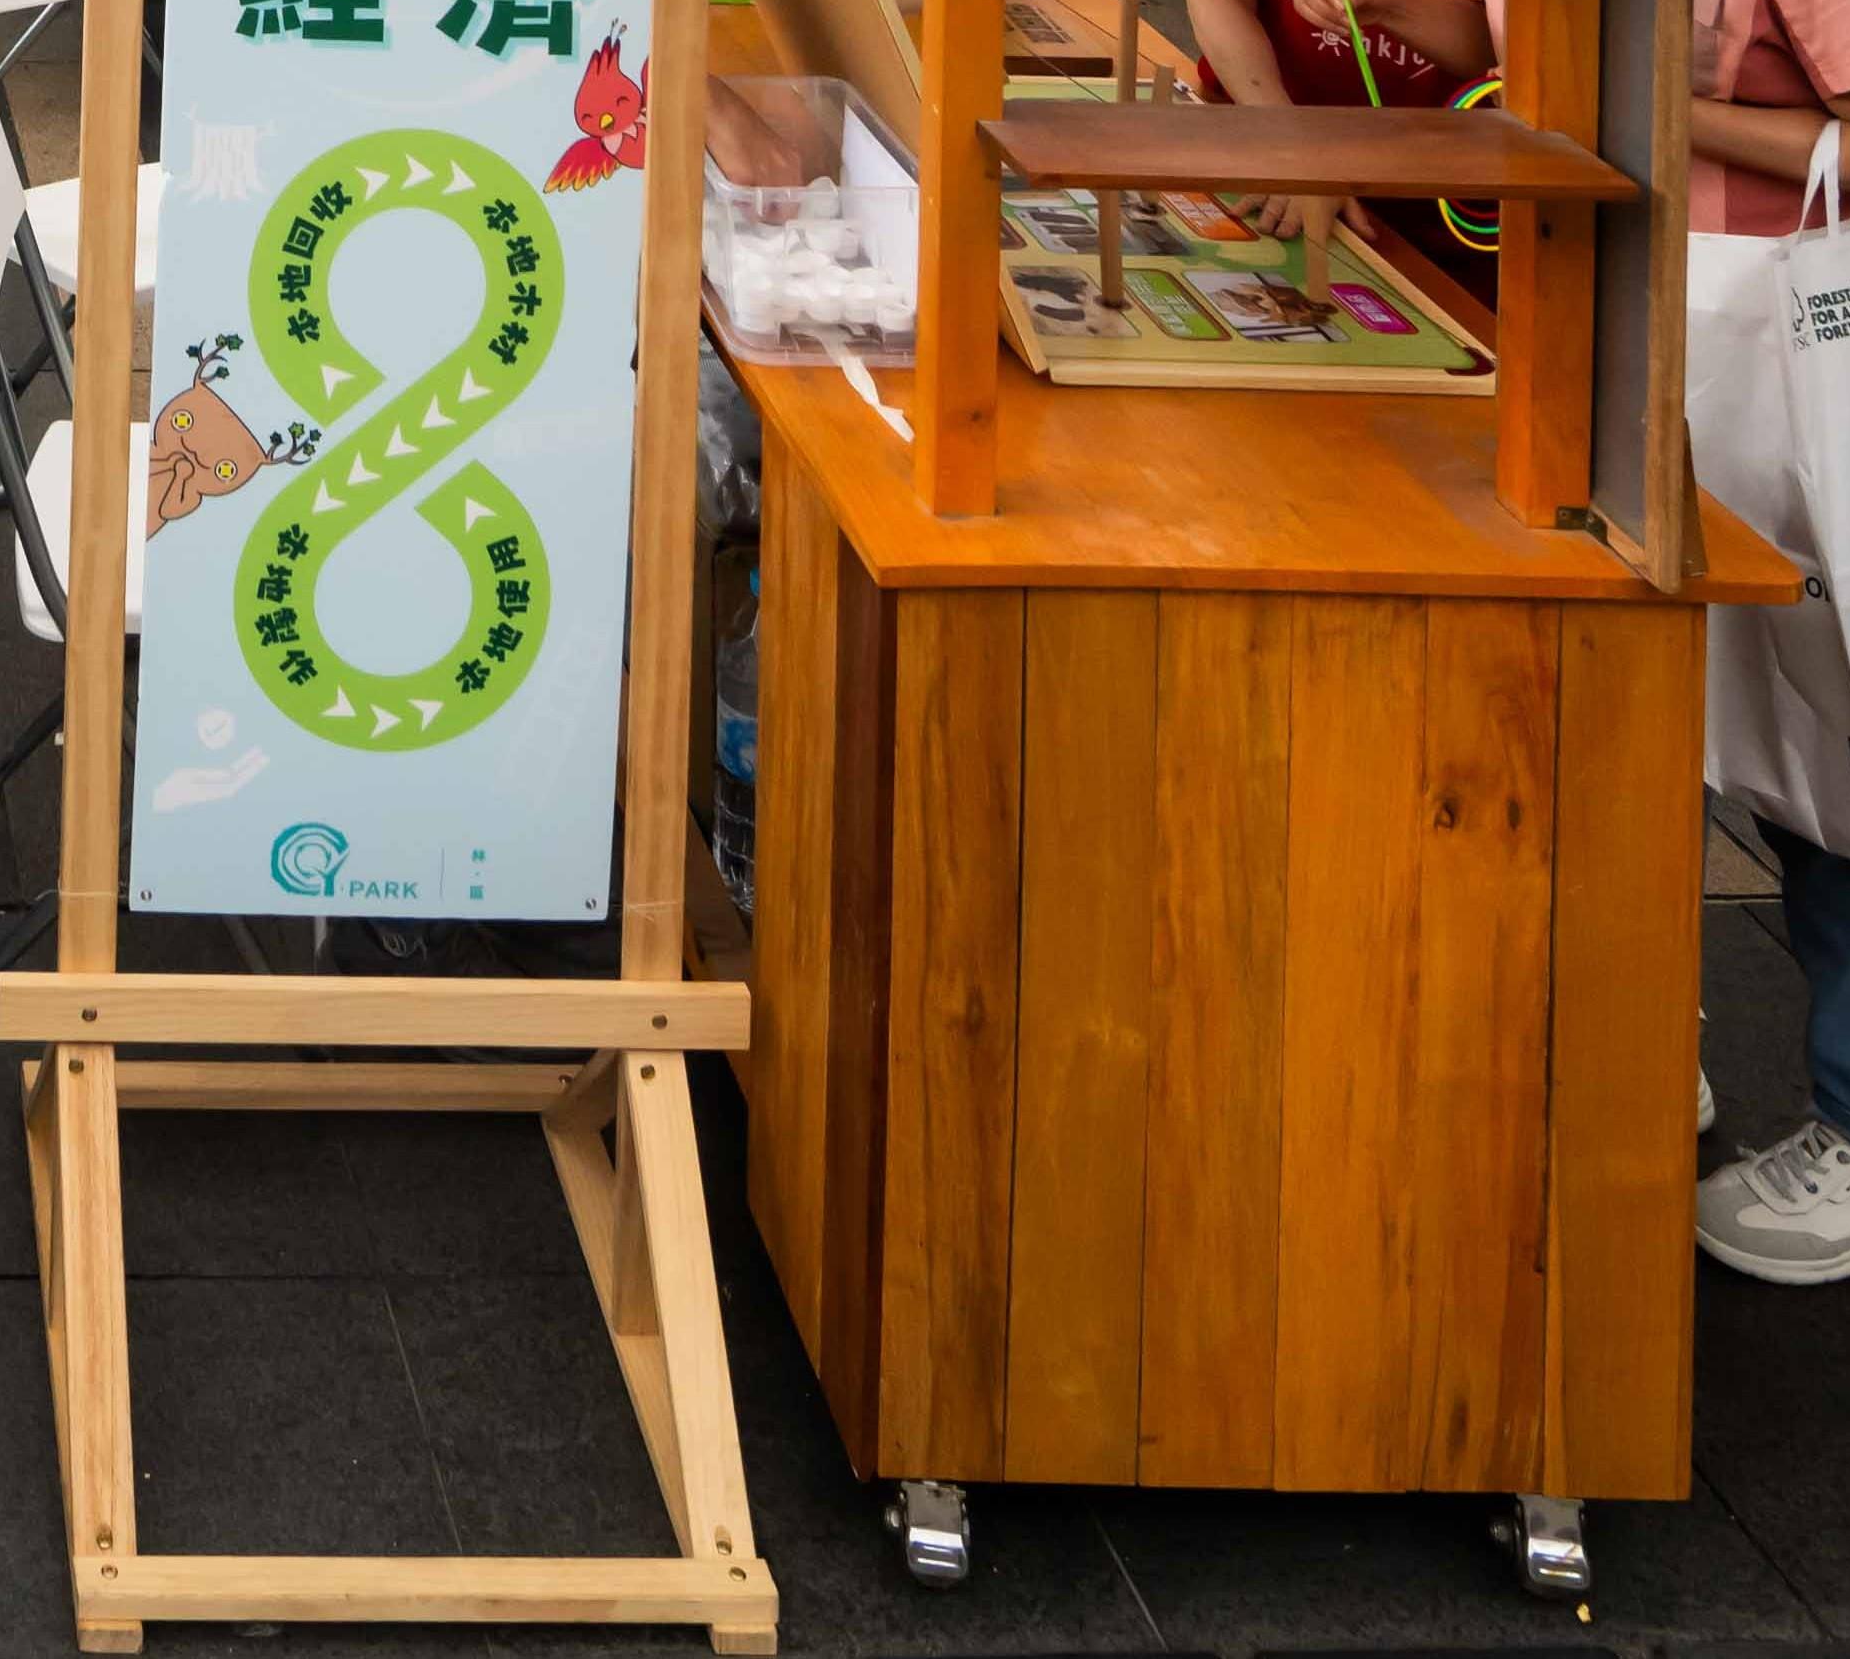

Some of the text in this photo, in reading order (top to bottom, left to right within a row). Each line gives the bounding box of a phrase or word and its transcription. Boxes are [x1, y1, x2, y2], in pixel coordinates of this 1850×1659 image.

[277, 181, 354, 345] 本地回收
[483, 196, 543, 367] 本地木材
[1810, 308, 1839, 326] FOR
[254, 523, 319, 686] 本地製作
[455, 535, 531, 693] 本地使用
